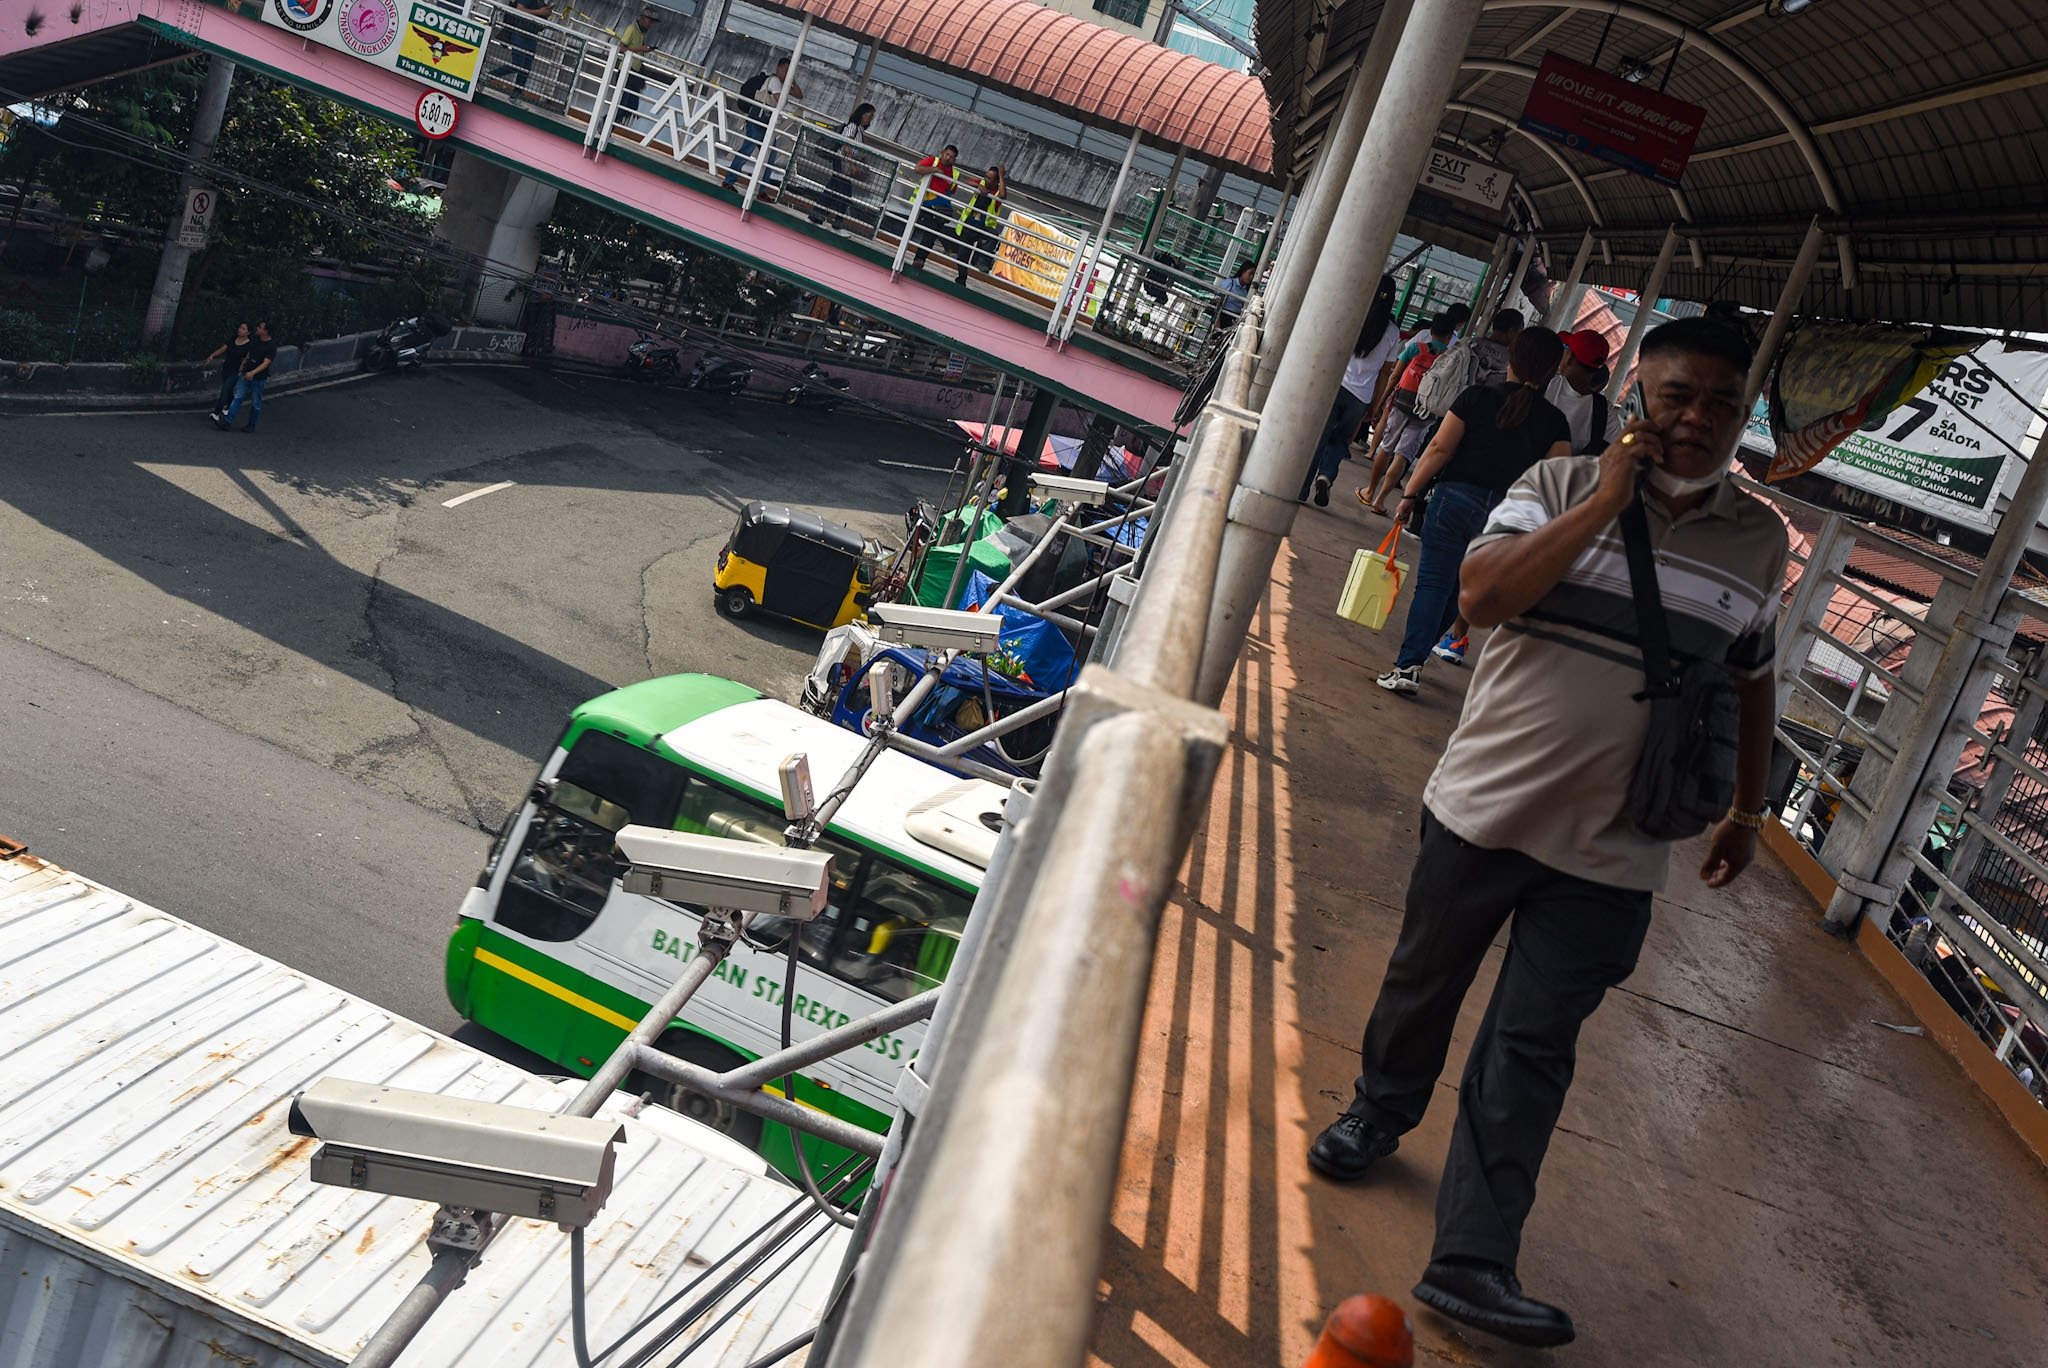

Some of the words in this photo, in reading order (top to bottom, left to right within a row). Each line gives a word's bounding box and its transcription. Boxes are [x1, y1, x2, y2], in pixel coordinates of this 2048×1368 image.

[295, 16, 324, 30] MANILA
[340, 10, 396, 54] PINAGLILINGKURAN
[414, 7, 479, 43] BOYSEN
[402, 59, 415, 71] The
[440, 73, 465, 90] PAINT
[420, 100, 441, 122] 5.80
[441, 110, 452, 127] m
[1544, 71, 1596, 98] MOVE
[1616, 99, 1644, 117] FOR
[1667, 119, 1694, 135] OFF
[1431, 153, 1471, 176] EXIT
[190, 215, 205, 226] NO
[1928, 426, 1981, 451] BALOTA
[1939, 419, 1957, 433] SA
[1862, 439, 1879, 450] AT
[1878, 444, 1927, 467] KAKAMPI
[1926, 460, 1944, 473] NG
[1943, 466, 1985, 486] BAWAT
[1904, 462, 1950, 484] PILIPINO
[1854, 458, 1909, 482] KALUSUGAN
[1921, 480, 1976, 503] KAUNLARAN
[652, 929, 748, 989] BATAN
